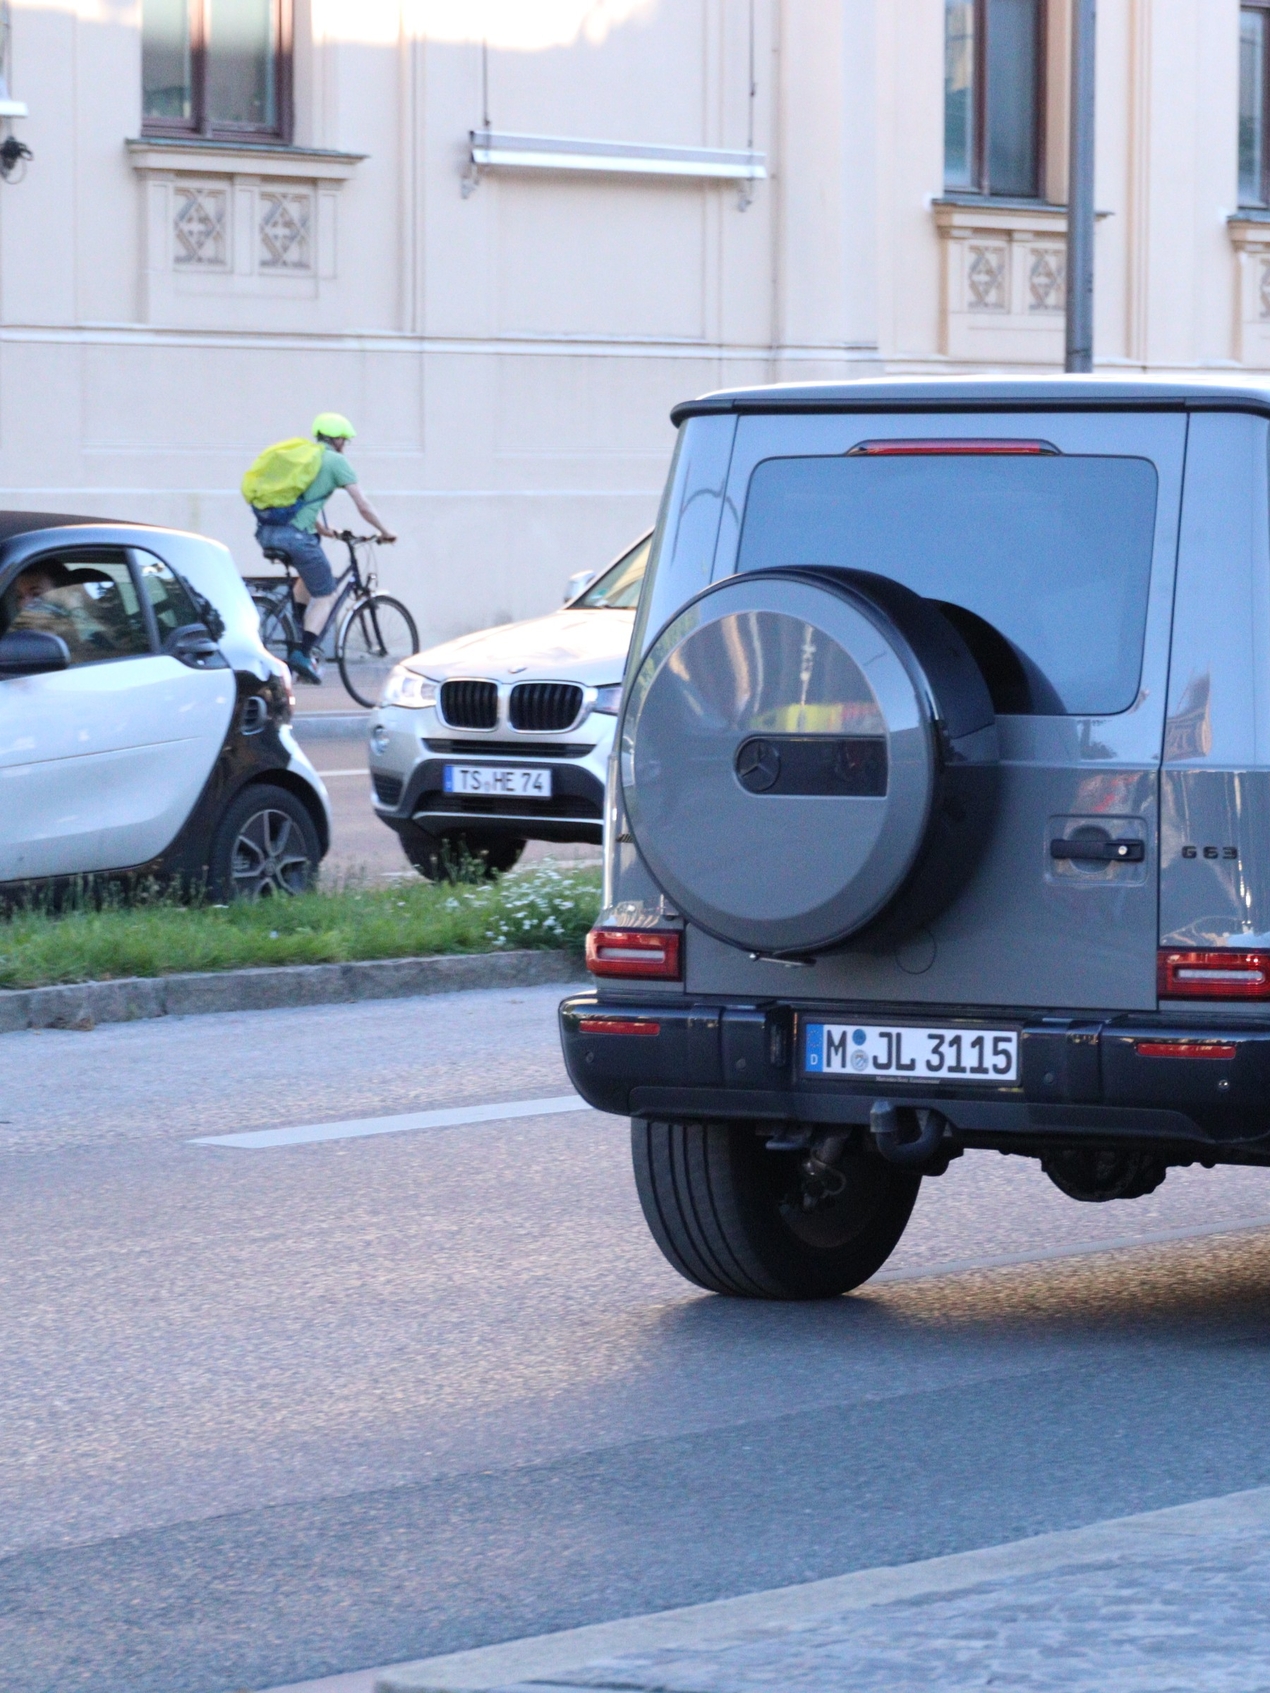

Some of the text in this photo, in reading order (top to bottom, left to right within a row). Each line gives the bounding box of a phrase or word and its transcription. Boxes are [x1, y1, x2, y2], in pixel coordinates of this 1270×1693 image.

[459, 769, 482, 790] TS
[492, 771, 515, 792] HE
[521, 772, 543, 793] 74
[1182, 845, 1238, 860] G 63
[810, 1053, 819, 1066] D
[826, 1029, 1013, 1075] M JL 3115
